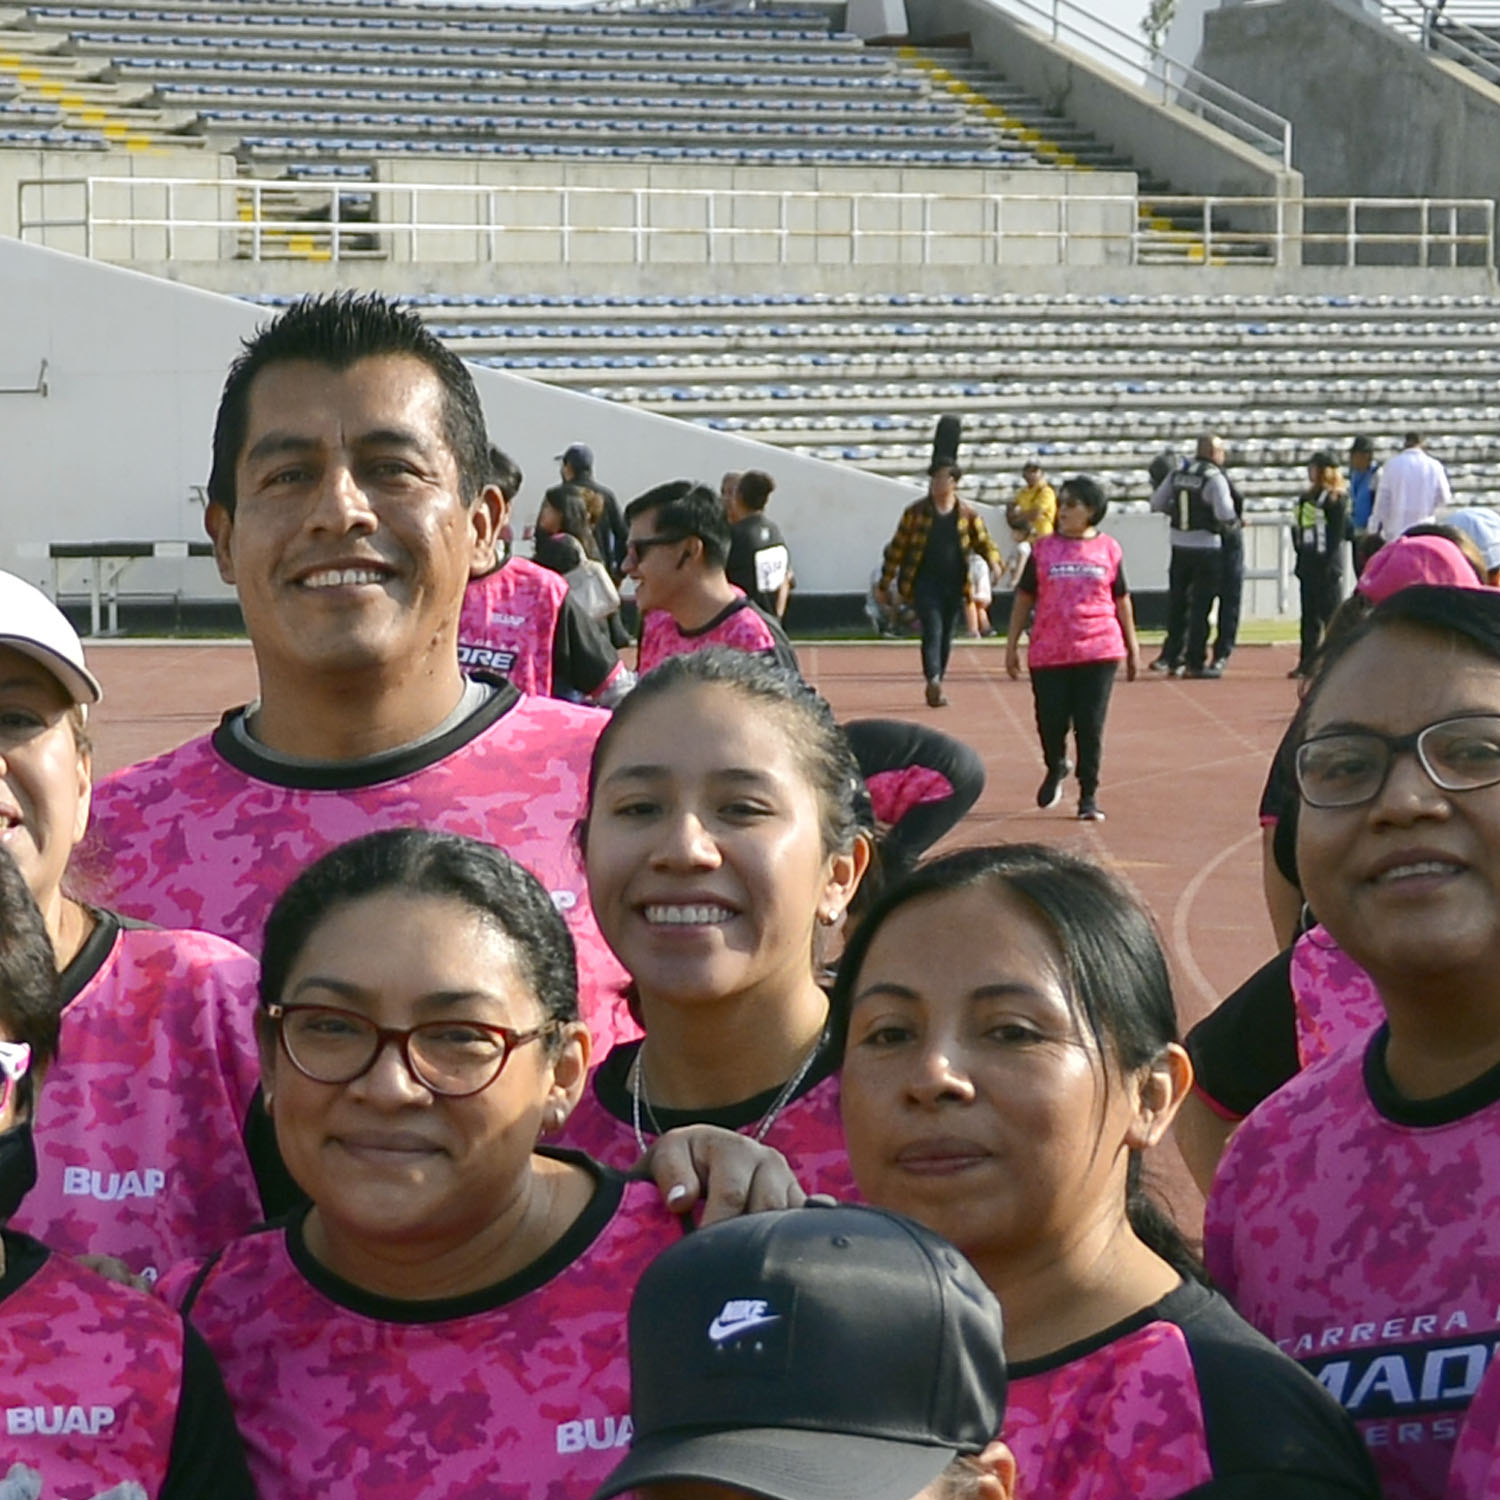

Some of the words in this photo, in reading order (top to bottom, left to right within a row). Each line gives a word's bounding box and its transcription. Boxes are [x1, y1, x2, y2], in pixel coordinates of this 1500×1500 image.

[63, 1165, 165, 1201] BUAP
[5, 1405, 116, 1436] BUAP
[555, 1416, 634, 1454] BUA
